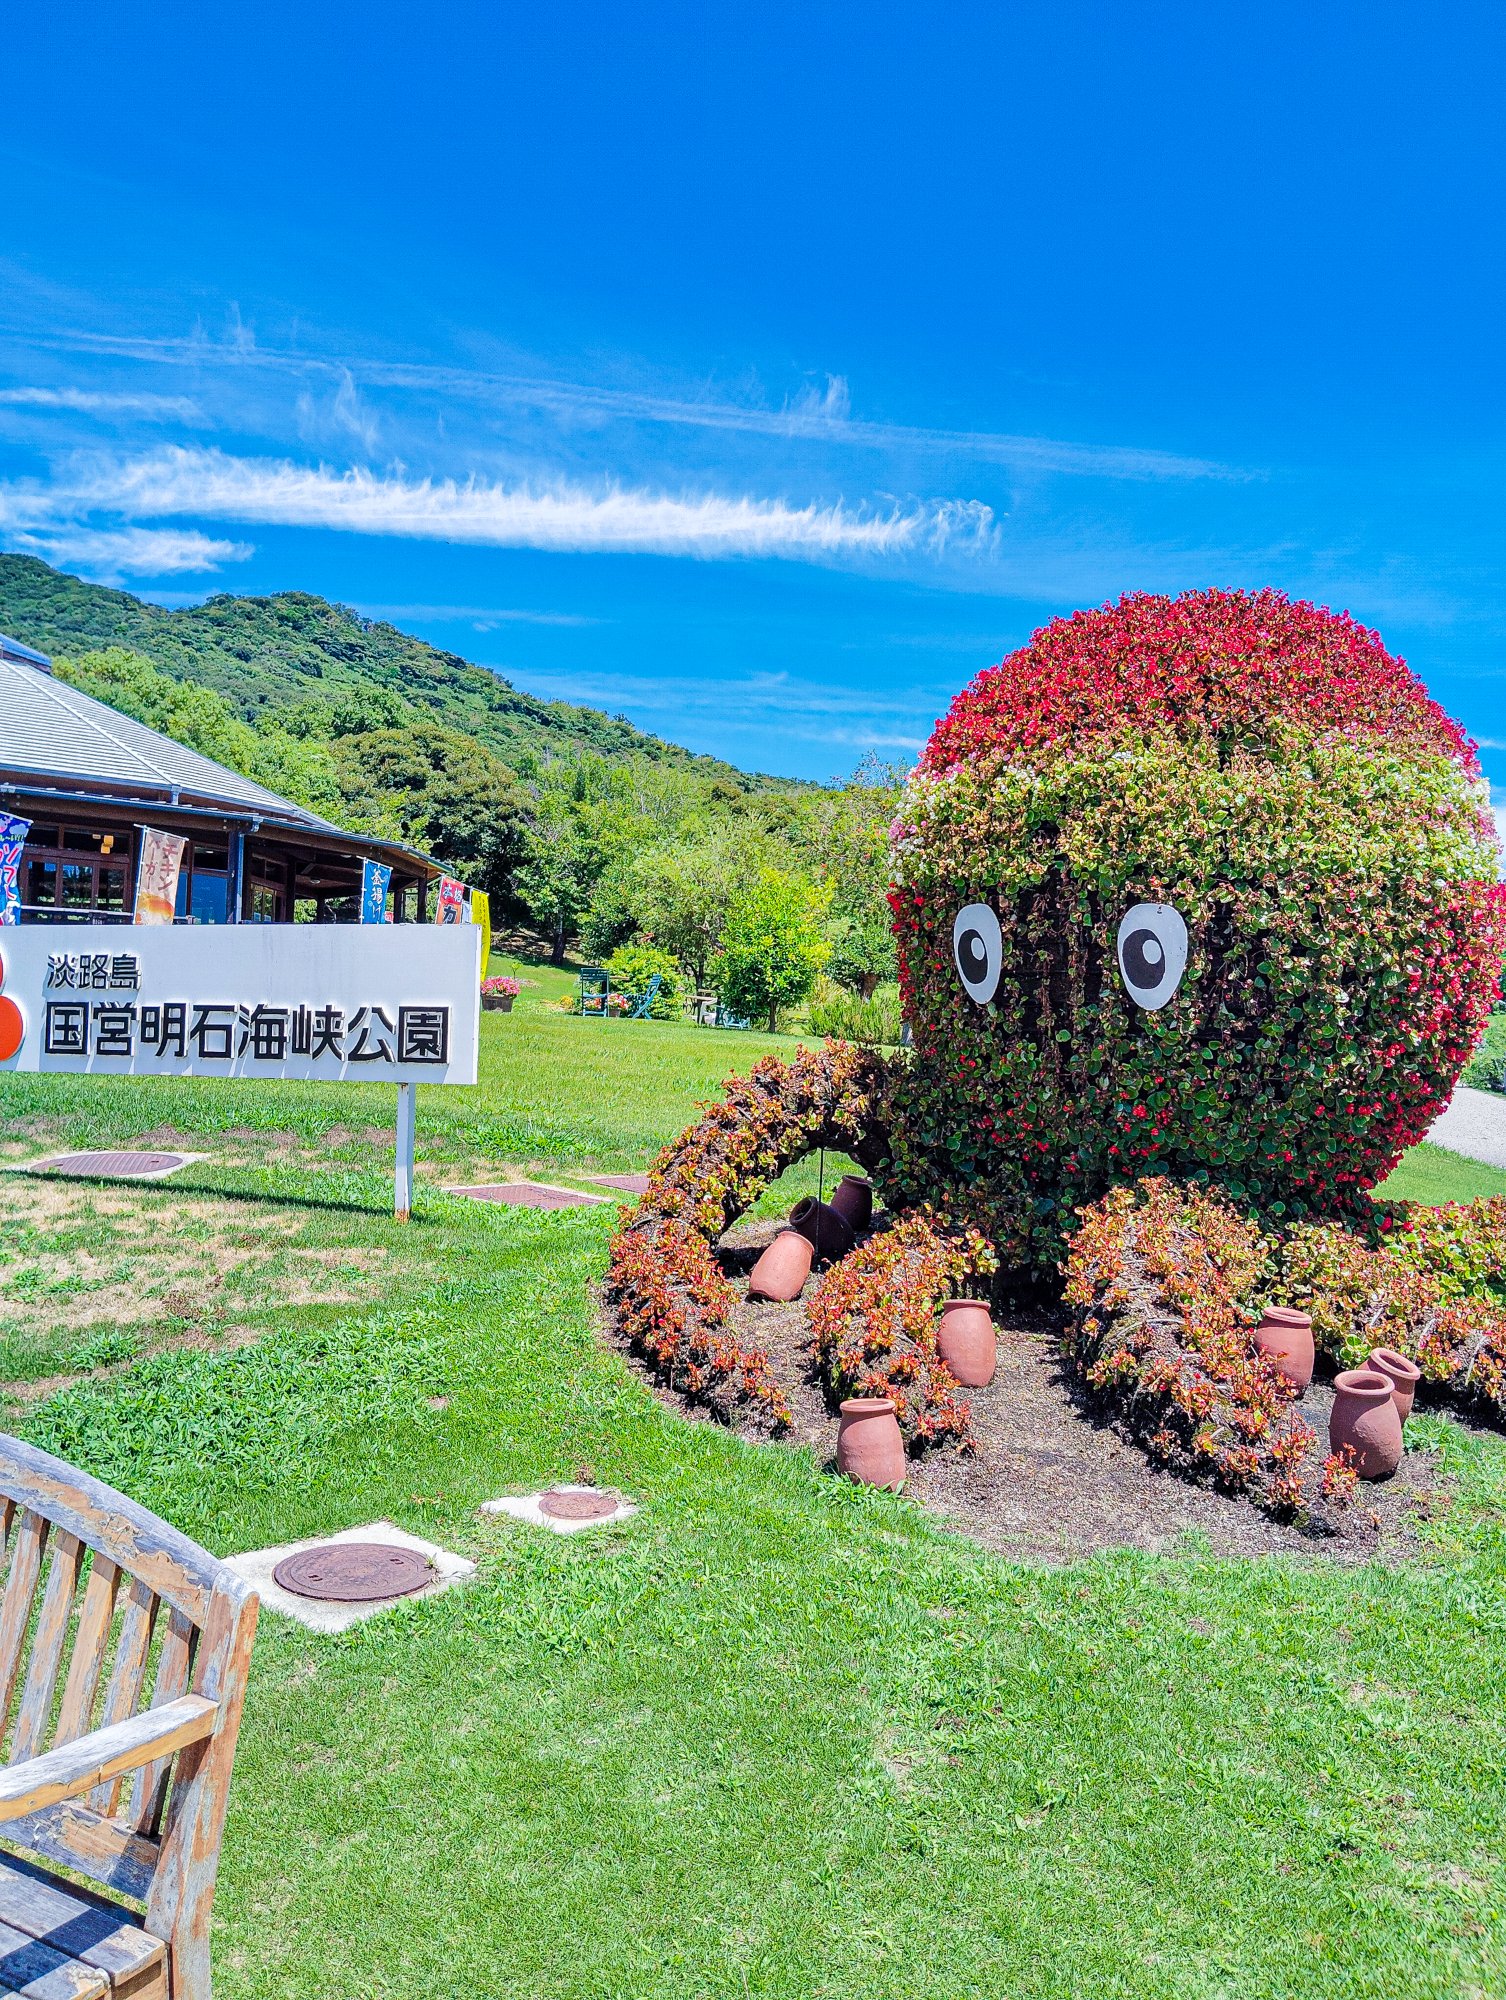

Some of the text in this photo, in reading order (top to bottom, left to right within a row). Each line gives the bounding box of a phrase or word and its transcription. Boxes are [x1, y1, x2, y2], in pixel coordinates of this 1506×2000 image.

[3, 843, 20, 900] ソフト
[146, 839, 161, 890] バーガー
[158, 843, 179, 891] チキン
[370, 867, 386, 924] 釜揚げ
[47, 953, 138, 990] 淡路島
[45, 1002, 450, 1064] 国営明石海峡公園
